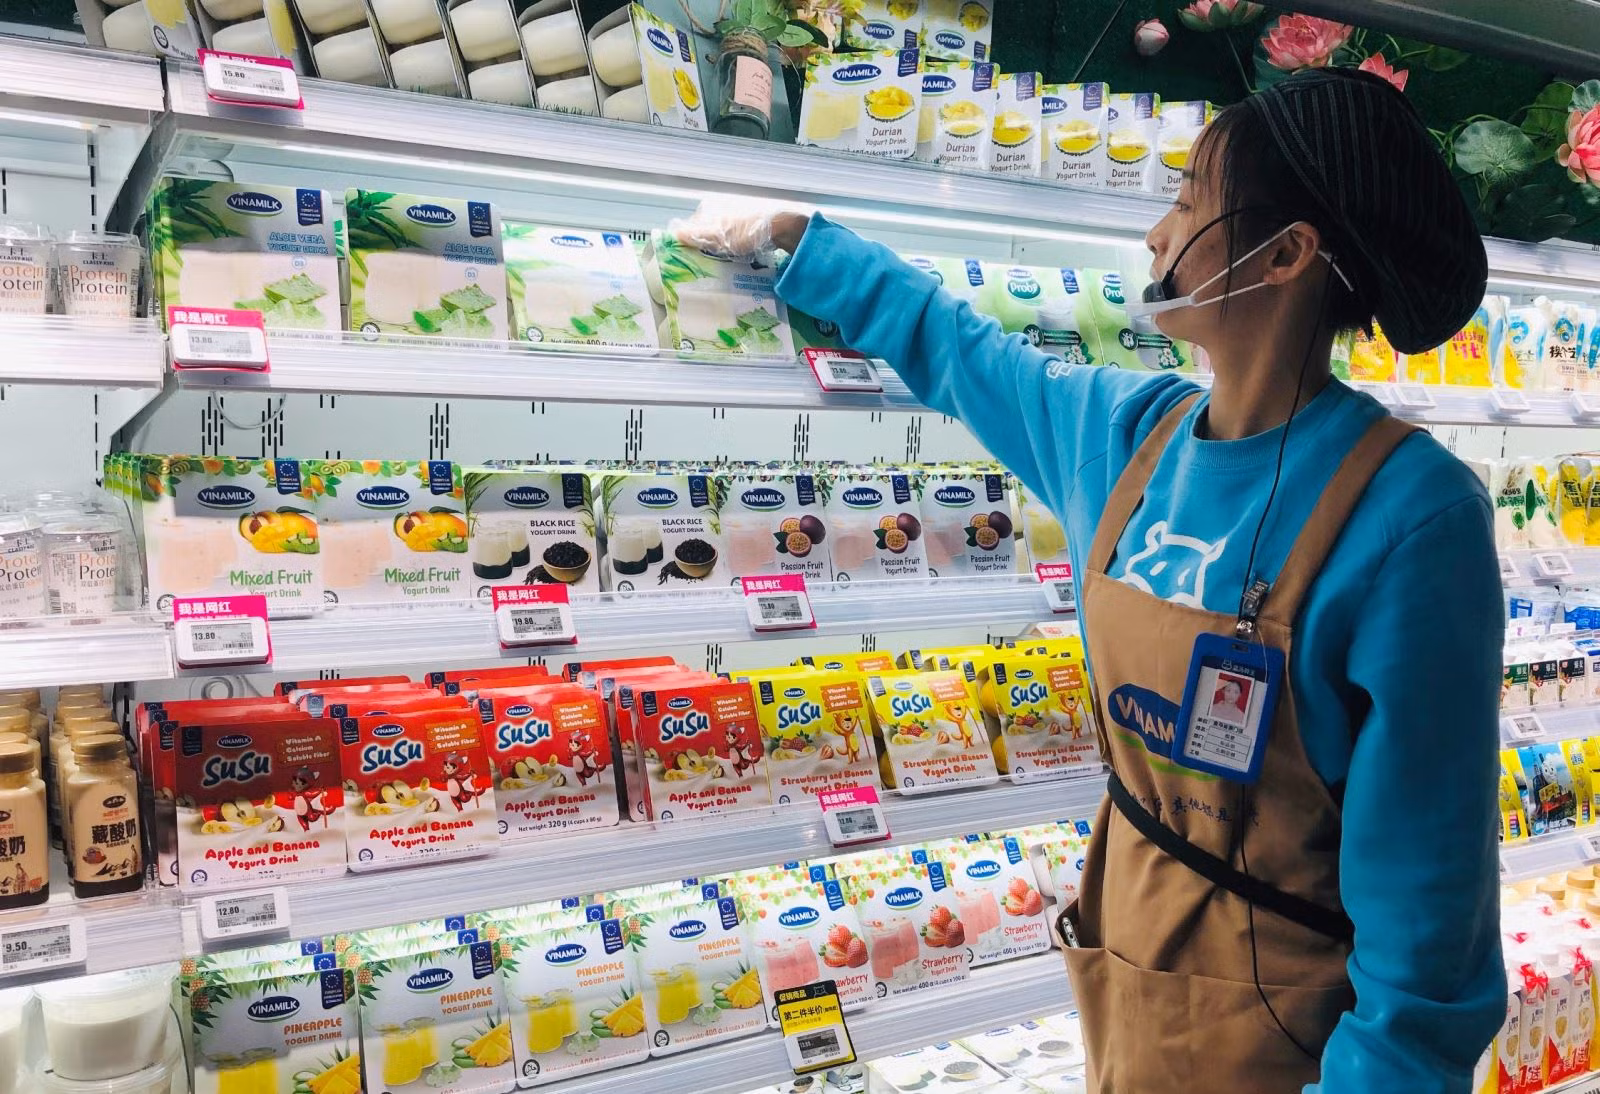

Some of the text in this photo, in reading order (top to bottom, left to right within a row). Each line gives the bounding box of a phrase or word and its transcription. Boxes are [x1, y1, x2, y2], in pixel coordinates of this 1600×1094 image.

[224, 70, 245, 79] 15.80
[836, 68, 880, 79] VINAMILK
[922, 80, 954, 89] NAMILK
[872, 127, 902, 137] Durian
[865, 137, 907, 146] Yogurt Drink
[946, 143, 976, 153] Durian
[940, 154, 961, 165] Yogurt
[997, 153, 1026, 162] Durian
[991, 164, 1012, 173] Yogurt
[1062, 160, 1091, 170] Durian
[1056, 171, 1097, 181] Yogurt Drink
[1112, 168, 1140, 178] Durian
[1106, 179, 1127, 188] Yogurt
[230, 197, 280, 210] VINAMILK
[409, 208, 454, 222] VINAMILK
[270, 232, 325, 244] ALOE VERA
[445, 243, 494, 255] ALOE VERA
[2, 265, 44, 279] otein
[70, 265, 128, 283] Protein
[0, 278, 43, 291] otein
[71, 278, 127, 295] Protein
[173, 310, 228, 325] 我是网红
[200, 491, 253, 501] VINAMILK
[359, 492, 408, 501] VINAMILK
[506, 492, 548, 501] VINAMILK
[639, 493, 677, 501] VINAMILK
[743, 494, 783, 502] VINAMILK
[844, 492, 882, 501] VINAMILK
[937, 491, 974, 500] VINAMILK
[662, 518, 686, 526] BLACK
[880, 557, 921, 567] Passion Fruit
[970, 553, 1010, 564] Passion Fruit
[781, 561, 823, 571] Passion Fruit
[885, 566, 918, 575] Yogurt Drink
[975, 563, 991, 572] Yogurt
[230, 569, 313, 586] Mixed Fruit
[384, 567, 461, 583] Mixed Fruit
[805, 571, 821, 579] Drink
[279, 589, 302, 598] Drink
[403, 586, 450, 597] Yogurt Drink
[497, 589, 540, 601] 我是网红
[178, 602, 232, 615] 我是网红
[514, 617, 534, 626] 19.80
[193, 632, 216, 640] 13.80
[1011, 682, 1049, 707] SuSu
[507, 707, 531, 715] VINAMILK
[892, 694, 932, 717] SuSu
[778, 701, 822, 729] SuSu
[375, 726, 402, 735] VINAMILK
[661, 711, 709, 742] SuSu
[286, 736, 314, 745] Vitamin
[498, 719, 550, 750] SuSu
[220, 737, 250, 745] VINAMILK
[313, 751, 330, 759] Fiber
[362, 738, 423, 773] SuSu
[1016, 749, 1056, 760] Strawberry
[1069, 744, 1095, 752] Banana
[903, 753, 989, 769] Strawberry and Banana
[1033, 755, 1083, 767] Yogurt Drink
[202, 751, 271, 788] SuSu
[923, 764, 977, 777] Yogurt Drink
[781, 769, 873, 785] Strawberry and Banana
[834, 781, 859, 790] Drink
[669, 785, 752, 803] Apple and Banana
[505, 793, 596, 812] Apple and Banana
[687, 796, 738, 810] Yogurt Drink
[524, 806, 580, 821] Yogurt Drink
[91, 818, 137, 844] 藏酸奶
[370, 820, 473, 841] Apple and Banana
[518, 820, 567, 833] Net weight: 320 g
[392, 833, 455, 849] Yogurt Drink
[205, 840, 320, 861] Apple and Banana
[228, 855, 299, 871] Yogurt Drink
[968, 864, 999, 875] VINAMILK
[887, 891, 922, 903] VINAMILK
[219, 906, 240, 916] 12.80
[781, 911, 817, 922] VINAMILK
[671, 924, 705, 937] VINAMILK
[1004, 921, 1043, 936] Strawberry
[6, 941, 28, 953] 9.50
[698, 937, 740, 952] PINEAPPLE
[547, 947, 585, 961] VINAMILK
[922, 953, 964, 970] Strawberry
[576, 962, 625, 978] PINEAPPLE
[409, 972, 451, 987] VINAMILK
[578, 974, 625, 988] YOGURT DRINK
[836, 974, 869, 988] awberry
[919, 982, 929, 990] 400
[440, 986, 493, 1005] PINEAPPLE
[251, 1000, 298, 1015] VINAMILK
[442, 1000, 493, 1015] YOGURT DRINK
[783, 1005, 823, 1021] 第二件半价
[284, 1017, 342, 1035] PINEAPPLE
[285, 1031, 342, 1046] YOGURT DRINK
